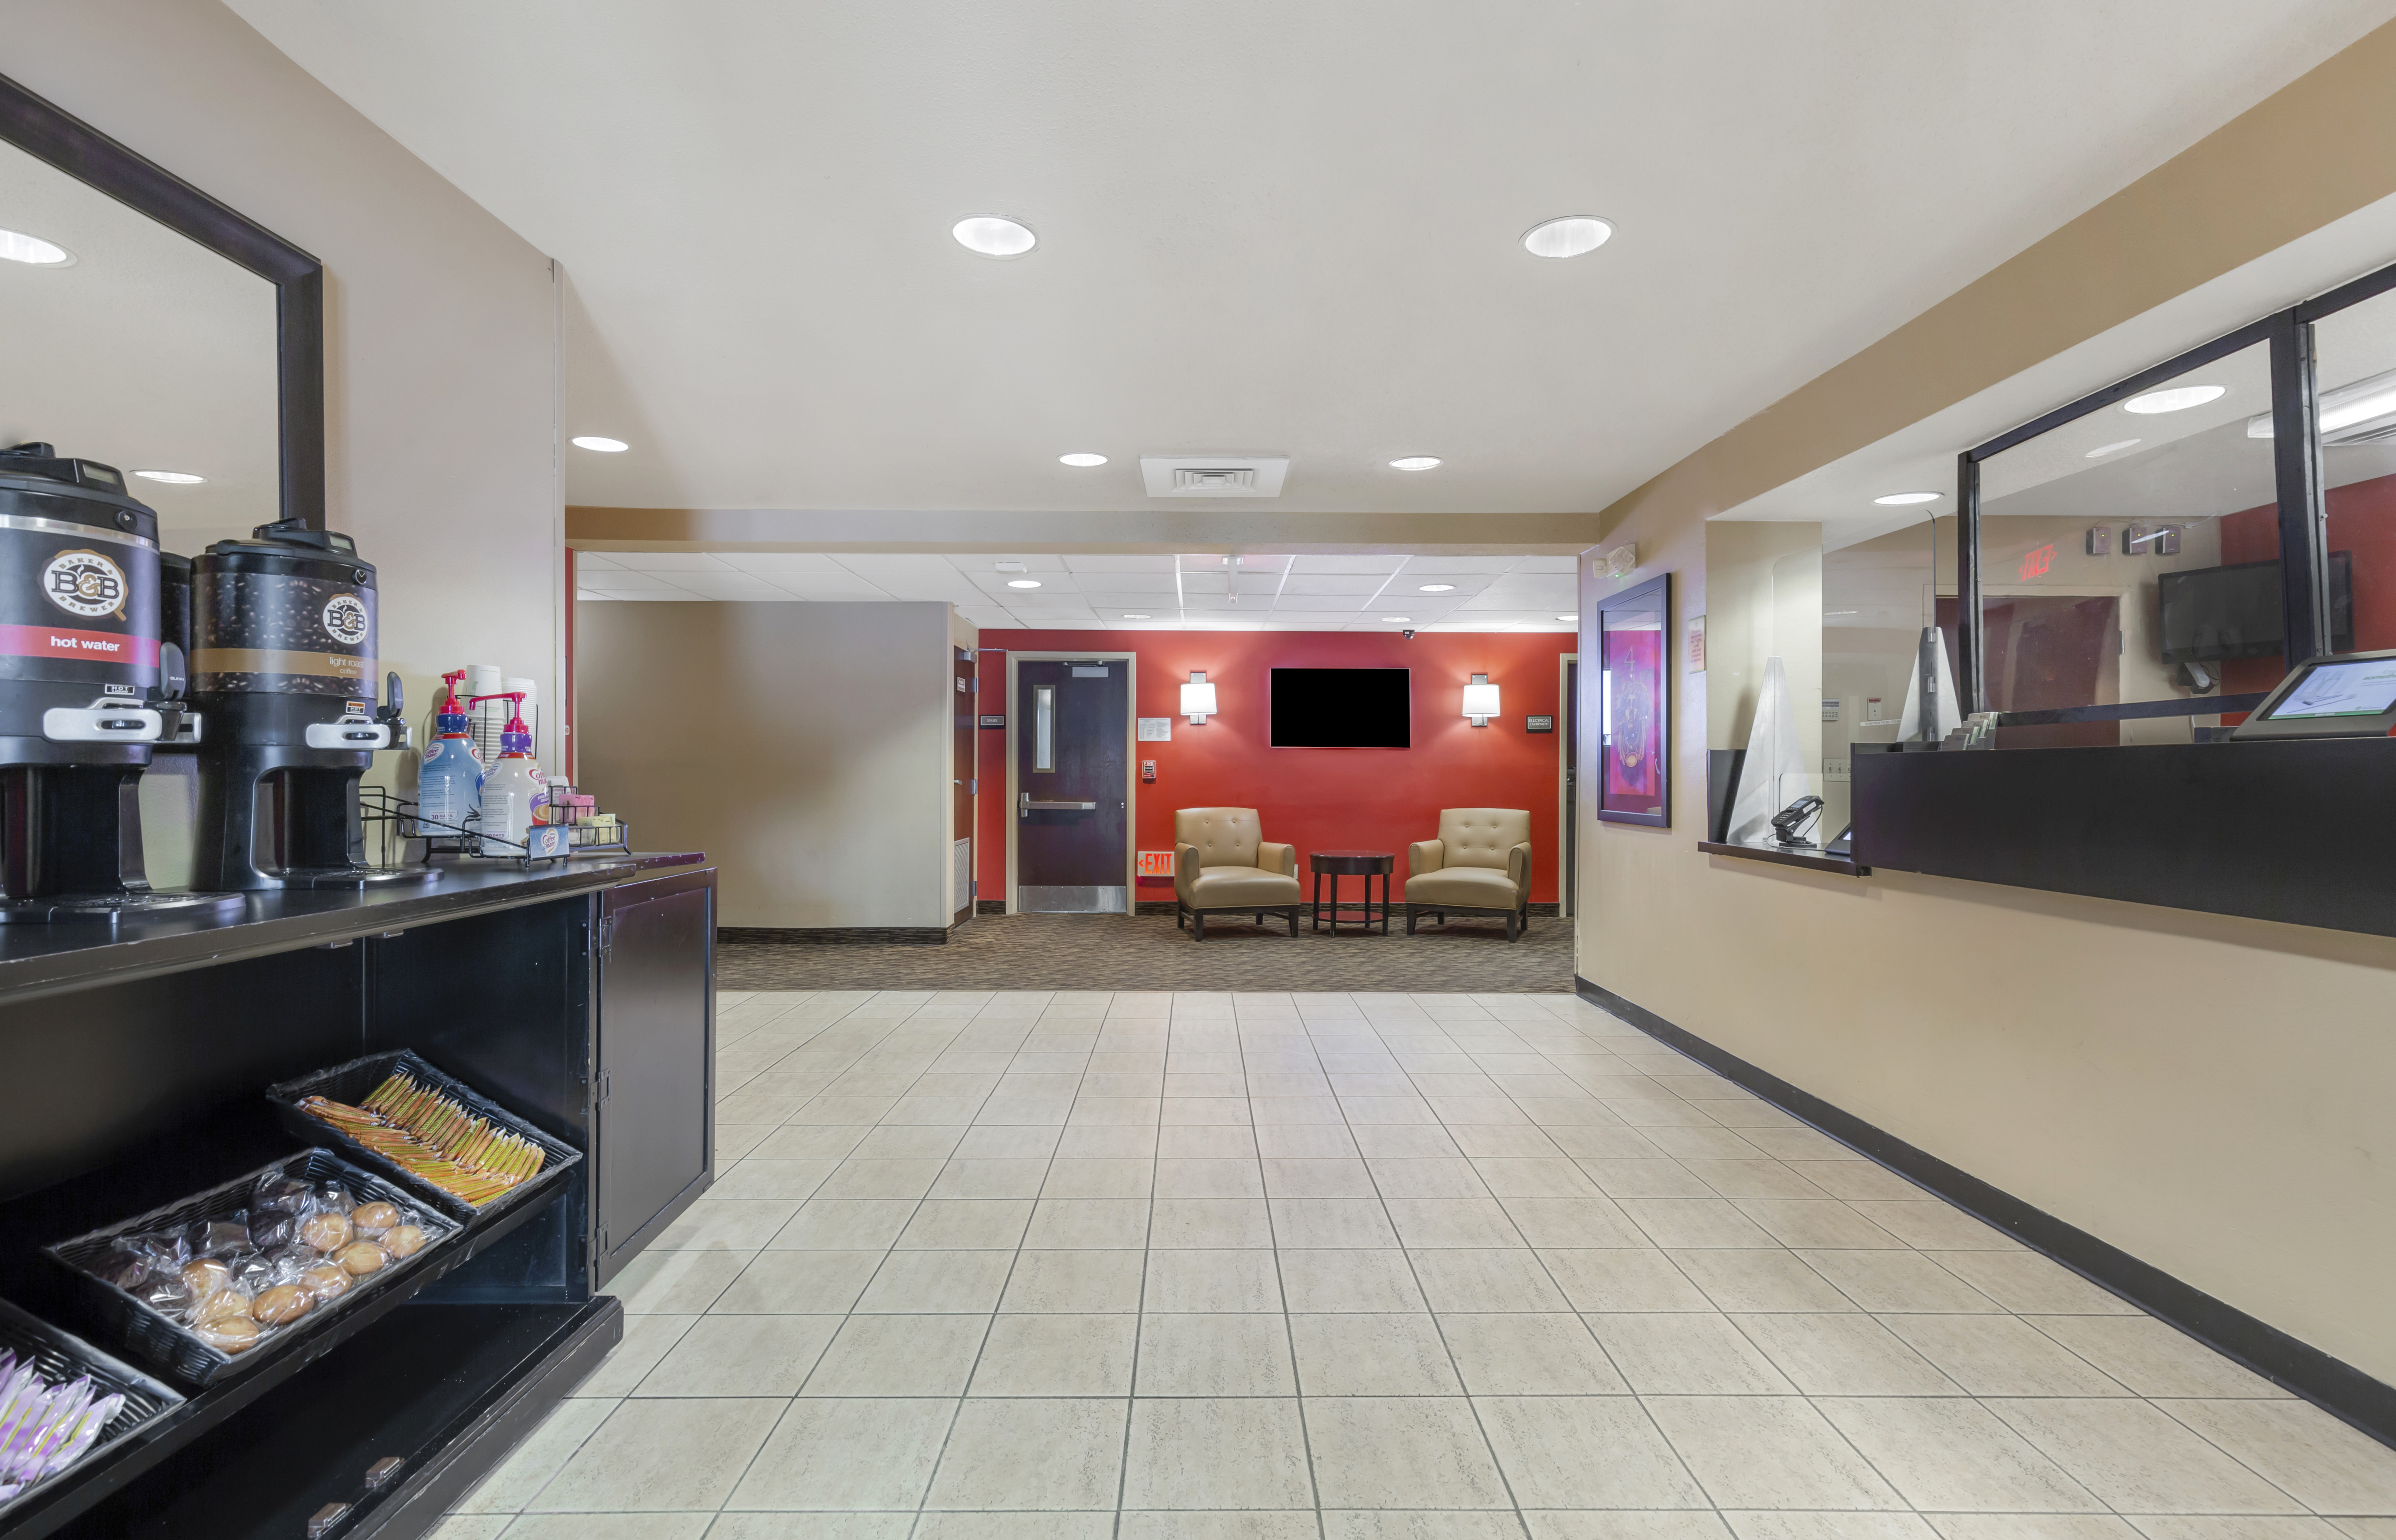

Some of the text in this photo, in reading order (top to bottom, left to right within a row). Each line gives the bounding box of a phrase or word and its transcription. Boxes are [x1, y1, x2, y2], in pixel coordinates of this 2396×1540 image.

[59, 558, 104, 569] BAKER
[51, 570, 119, 599] B&B
[59, 596, 114, 612] BREWER
[332, 600, 358, 609] BAKER
[327, 609, 366, 631] B&B
[332, 629, 363, 641] BREWER
[51, 636, 120, 651] hot water
[330, 657, 346, 667] light
[542, 835, 556, 845] Coffee
[1145, 854, 1172, 874] EXIT
